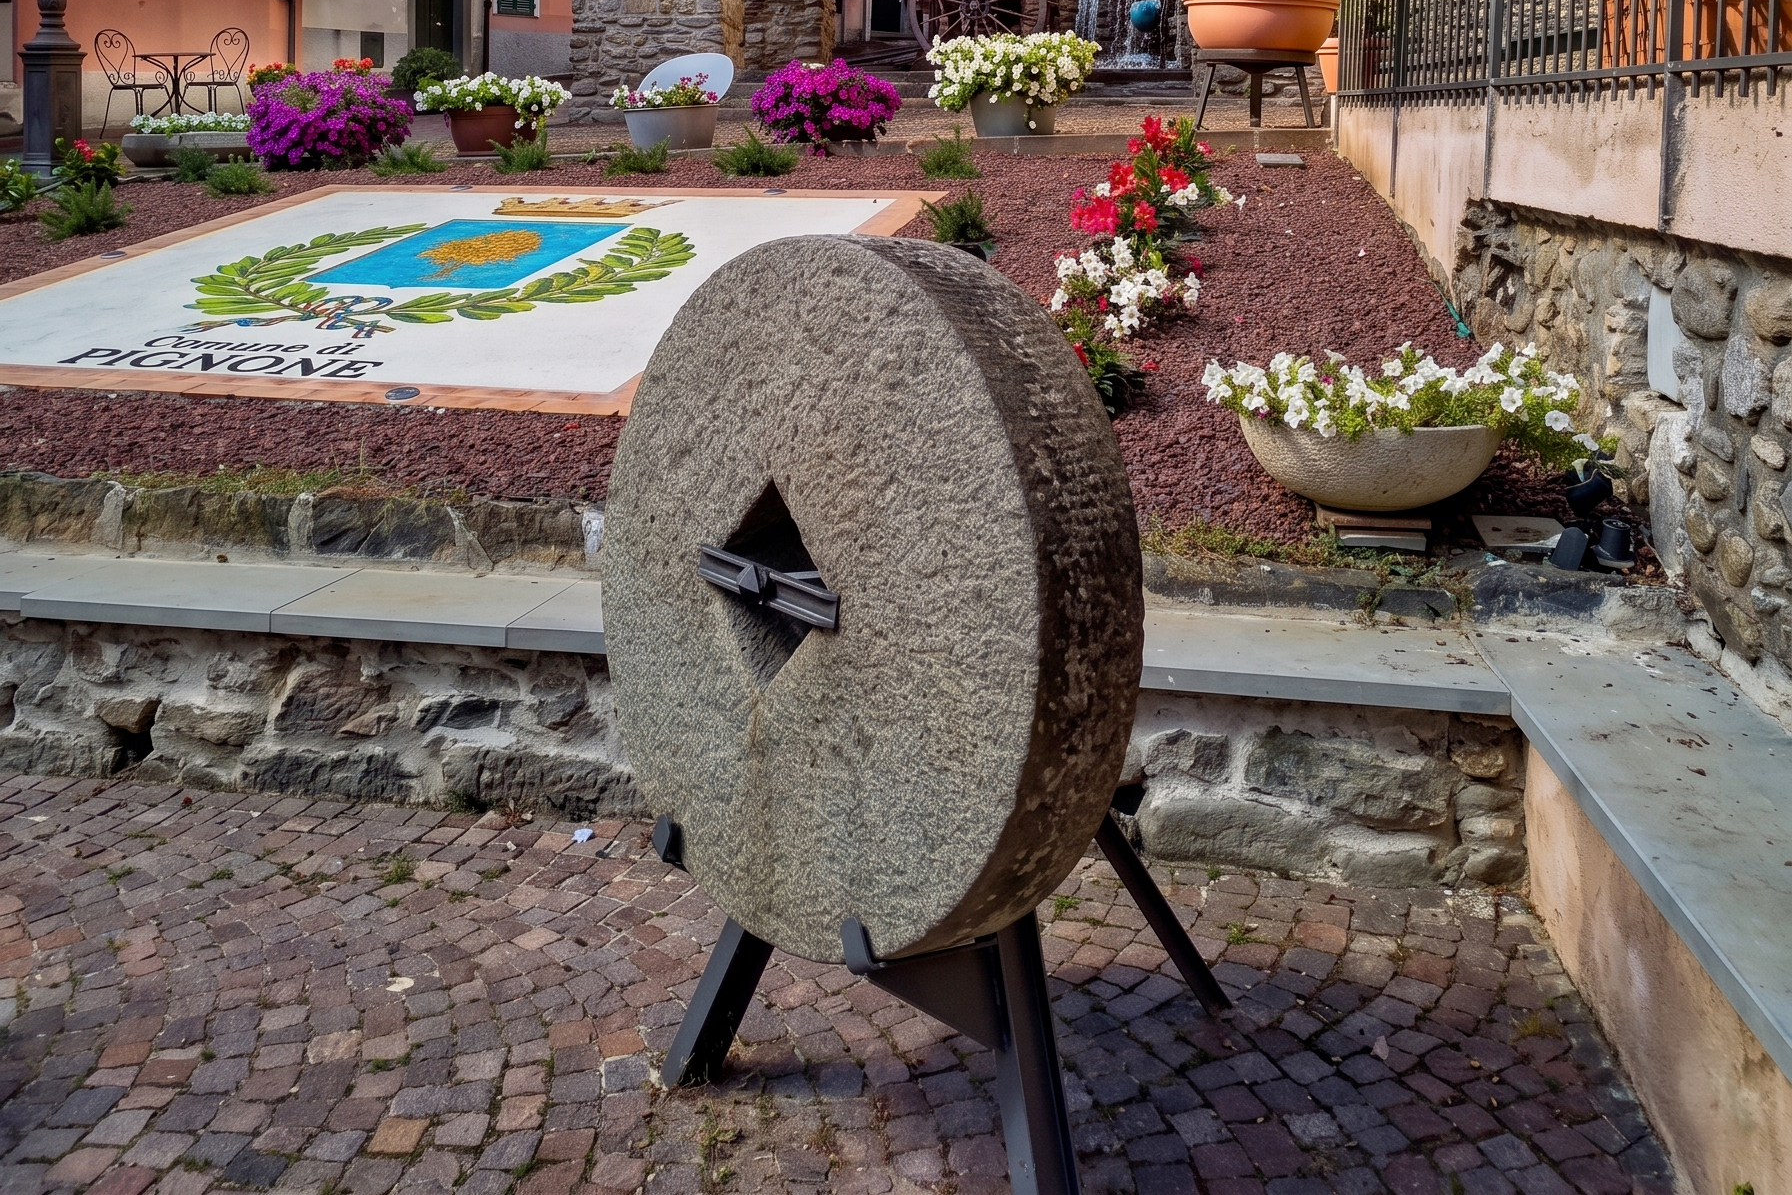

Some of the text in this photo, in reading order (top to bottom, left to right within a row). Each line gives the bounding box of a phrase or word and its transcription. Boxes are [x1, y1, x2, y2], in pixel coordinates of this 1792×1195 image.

[145, 335, 366, 355] Comune di
[57, 348, 384, 378] PIGNONE
